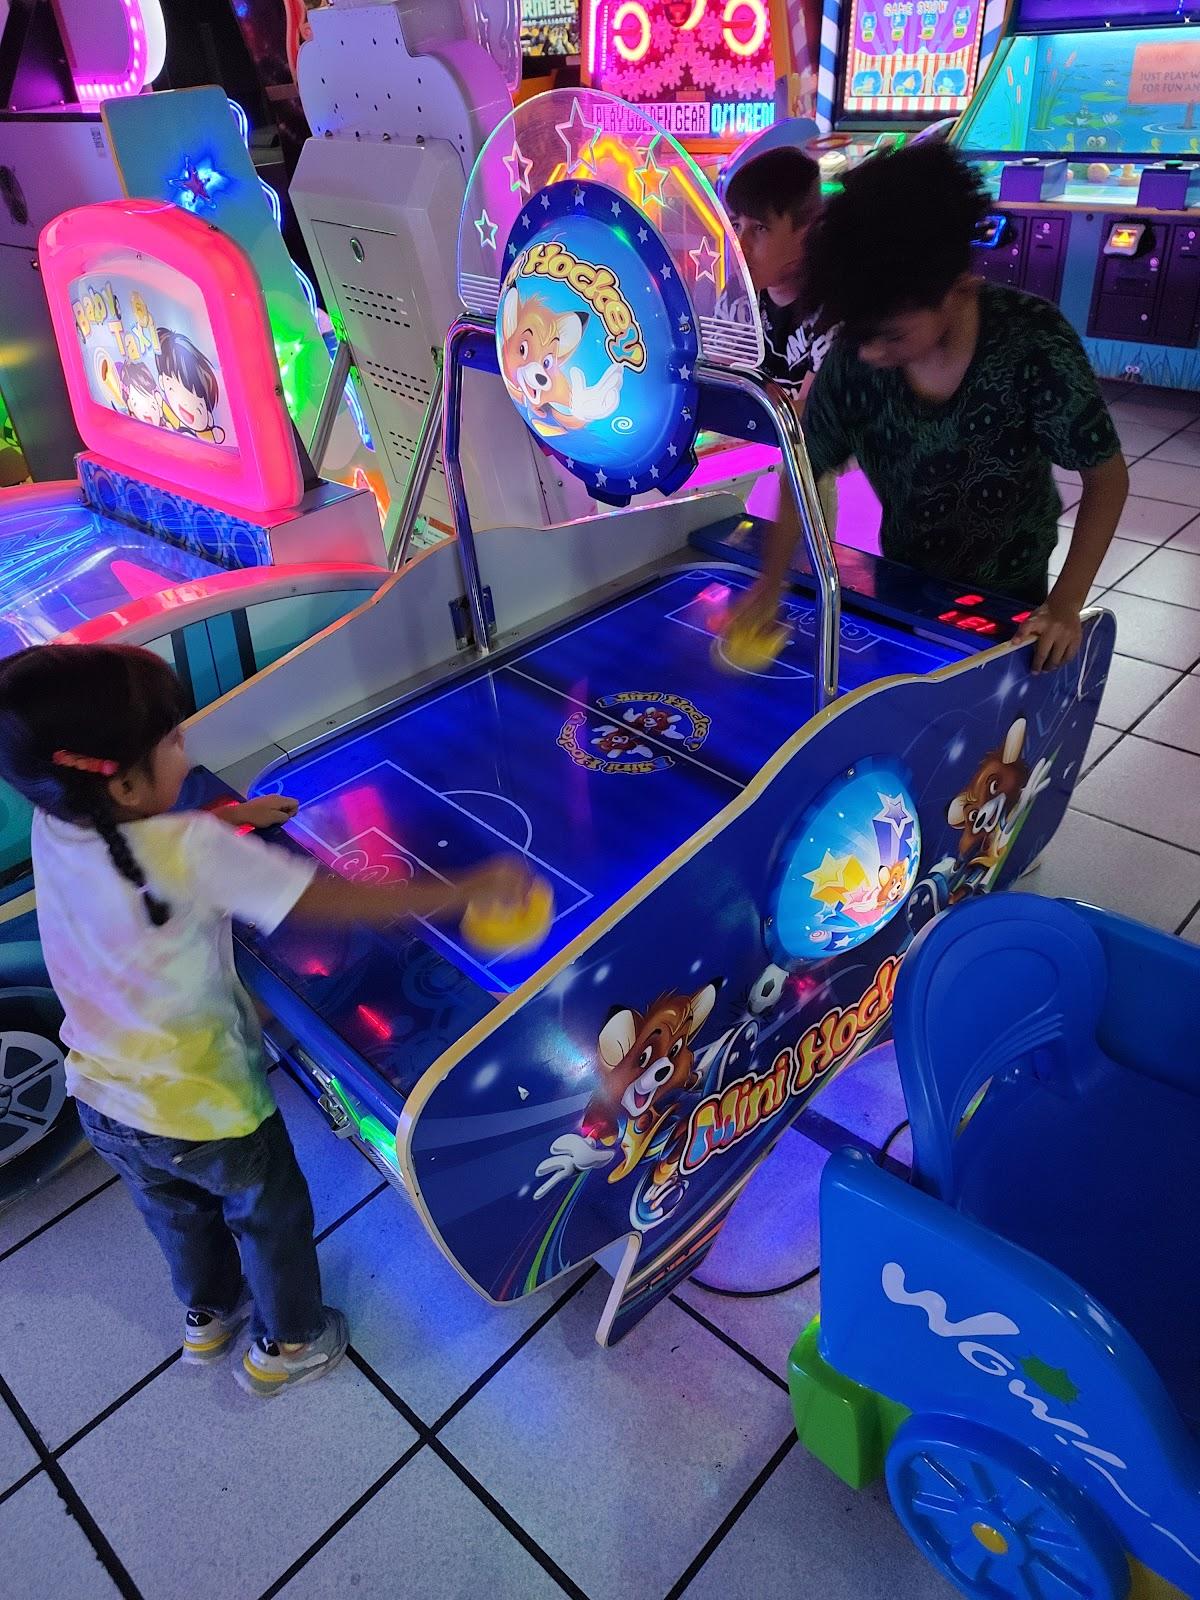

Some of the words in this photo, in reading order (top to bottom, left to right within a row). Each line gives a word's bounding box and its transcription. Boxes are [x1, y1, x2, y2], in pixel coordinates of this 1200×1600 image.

[1162, 83, 1183, 92] FUN
[1164, 71, 1187, 80] PLAY
[595, 104, 624, 131] PLAY
[675, 104, 706, 131] GEAR
[72, 280, 120, 341] Baby
[520, 241, 646, 373] Hockey
[681, 1048, 792, 1175] Mini
